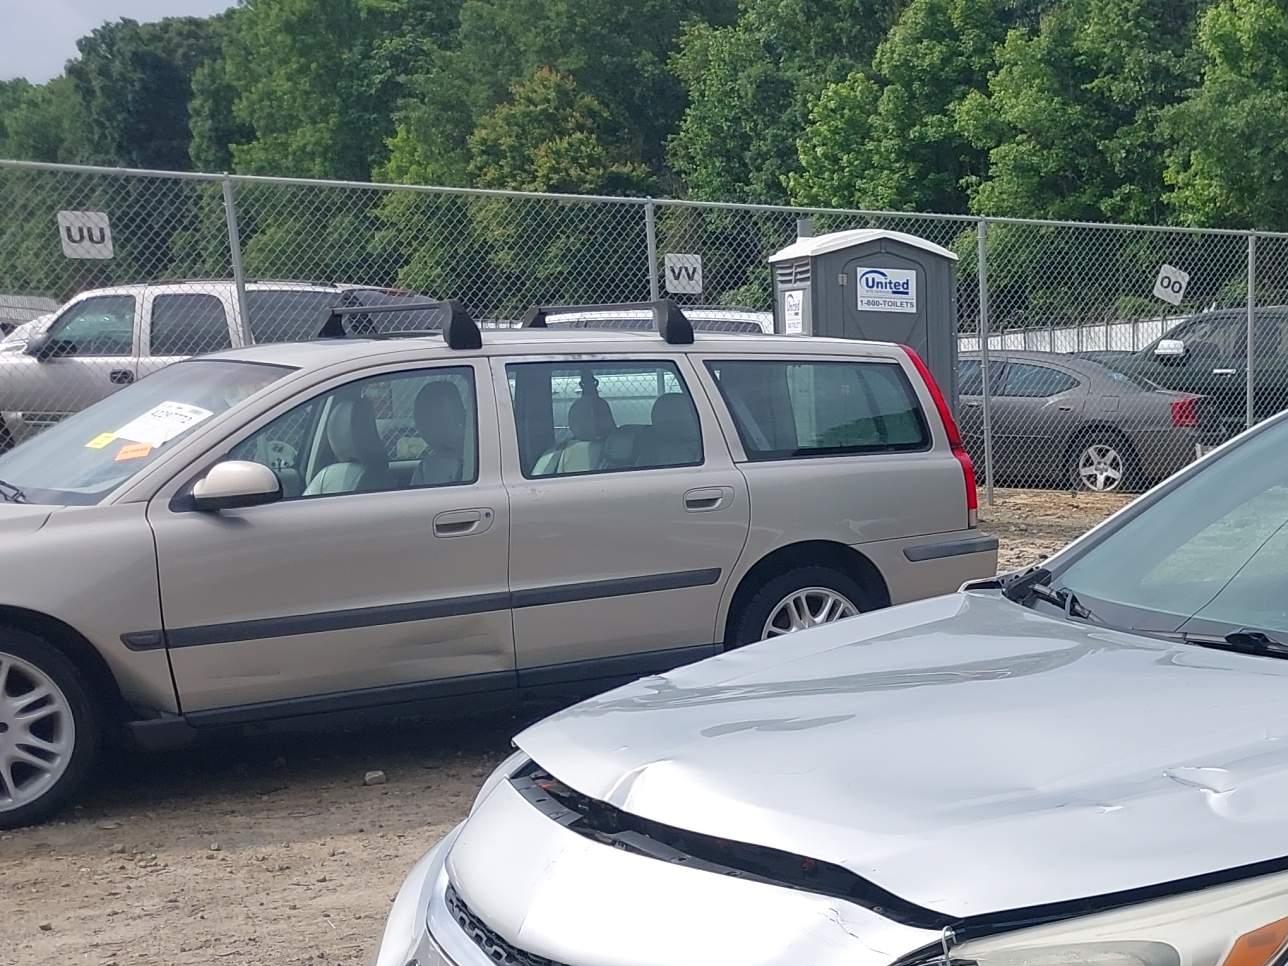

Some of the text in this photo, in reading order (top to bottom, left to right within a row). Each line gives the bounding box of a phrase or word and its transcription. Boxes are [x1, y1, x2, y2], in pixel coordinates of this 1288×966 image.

[65, 225, 106, 245] UU
[865, 276, 910, 290] United
[860, 299, 915, 309] 1-800-TOILETS
